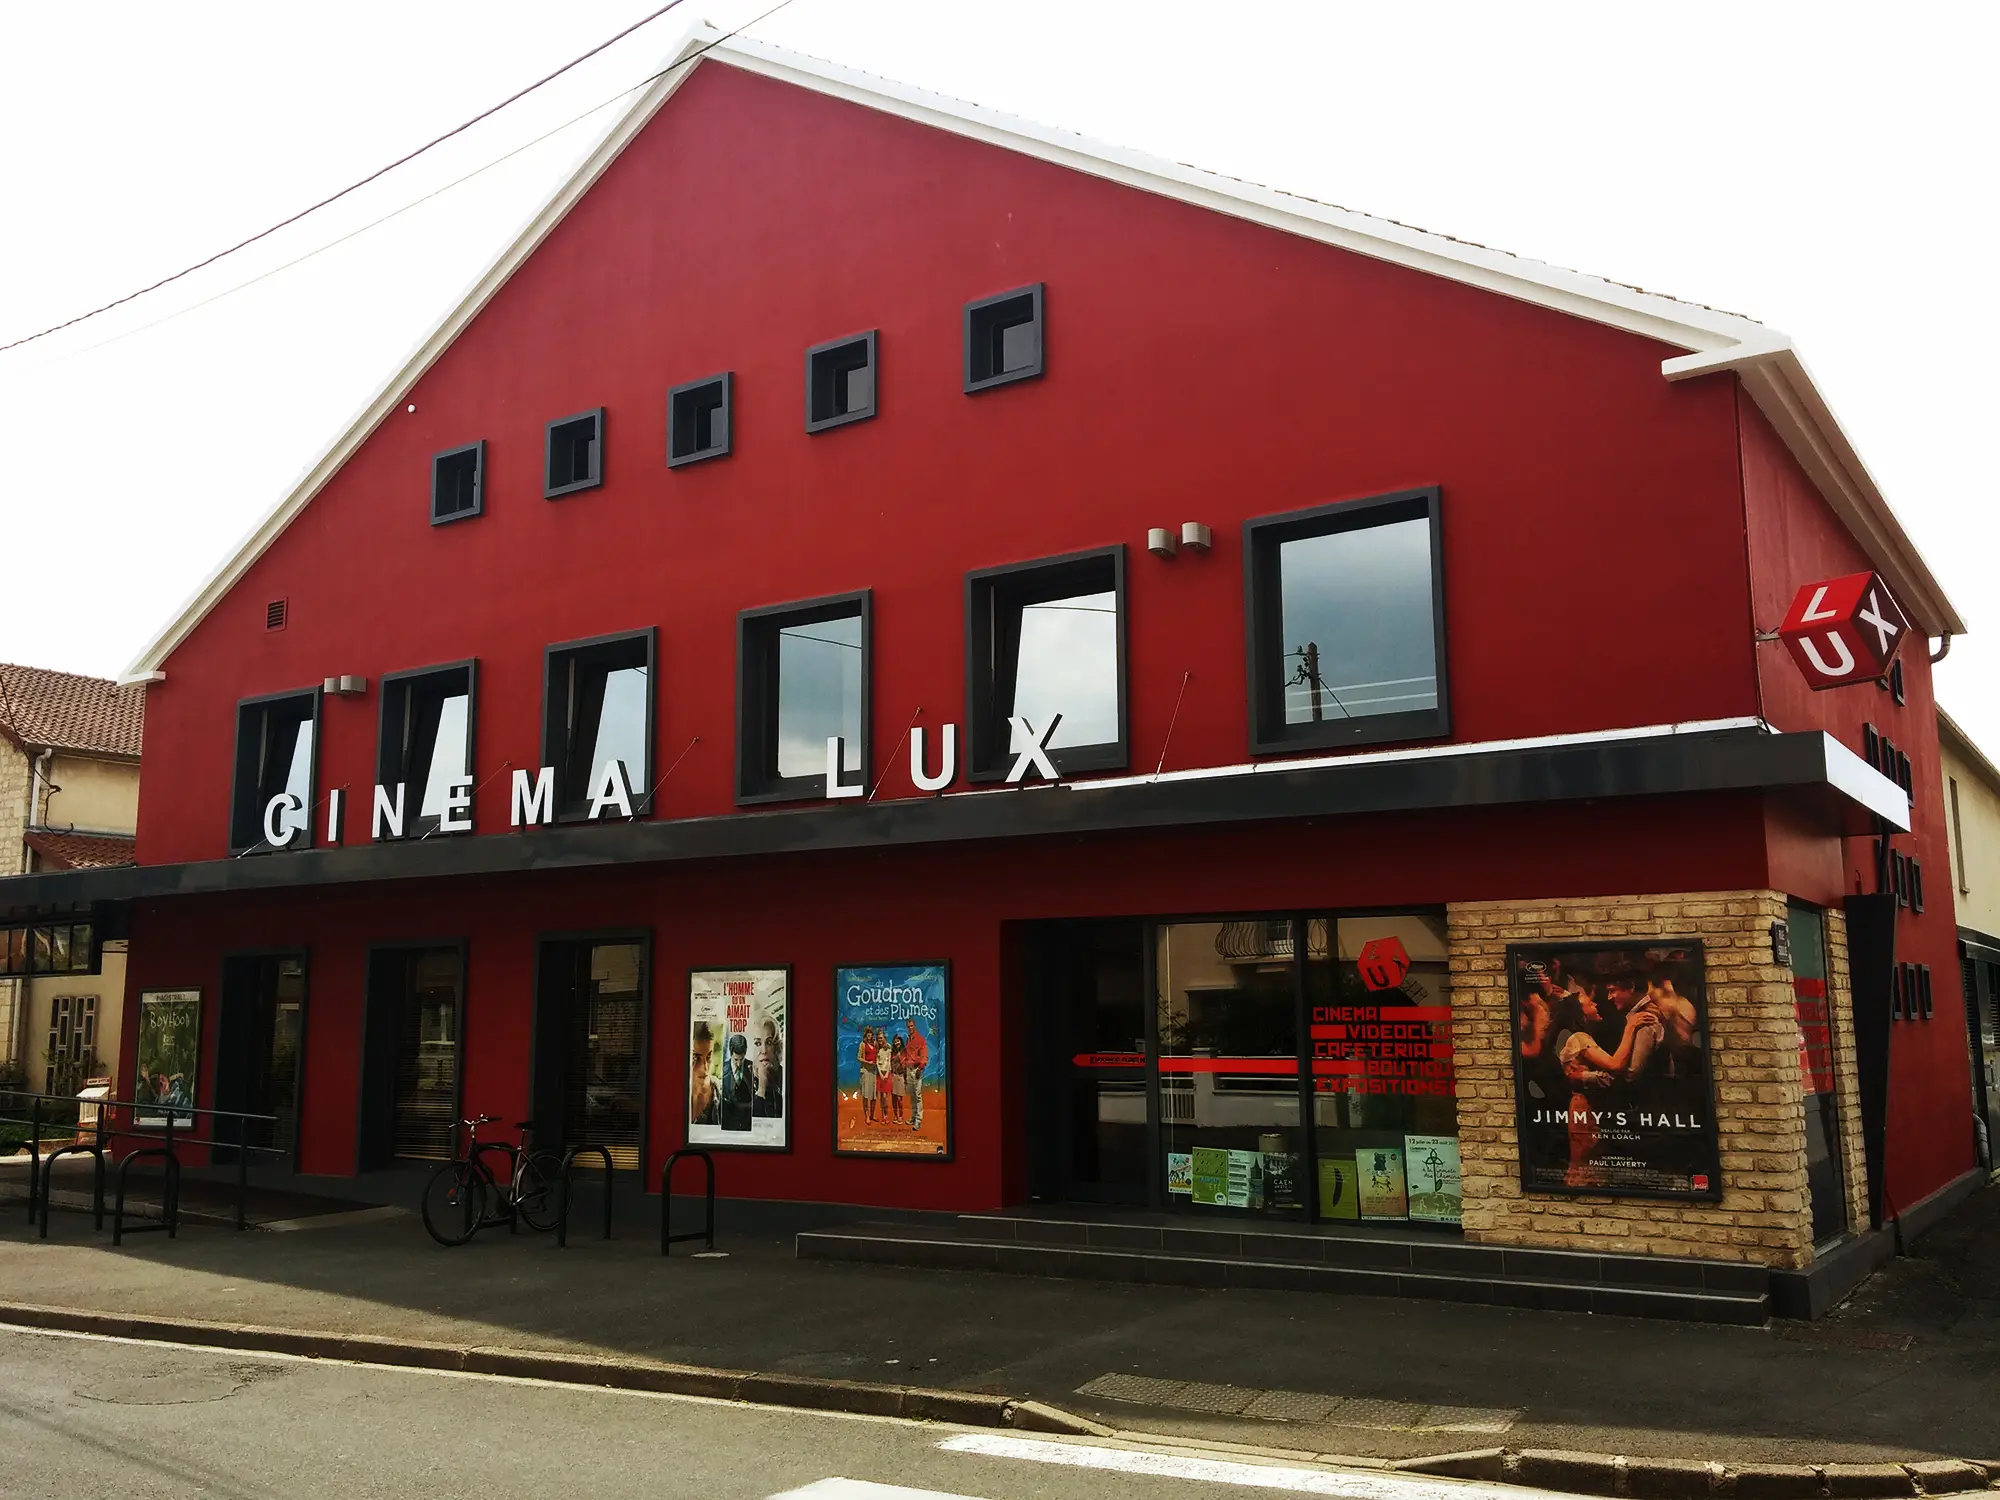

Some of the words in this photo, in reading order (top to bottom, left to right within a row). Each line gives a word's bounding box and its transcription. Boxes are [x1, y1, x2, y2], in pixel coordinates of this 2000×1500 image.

[1800, 586, 1899, 676] LUX
[264, 759, 634, 848] CINEMA
[826, 713, 1063, 799] LUX
[723, 982, 755, 996] L'HOMME
[847, 979, 924, 1006] Goudron
[727, 1005, 751, 1018] AIMAIT
[865, 1006, 873, 1015] et
[874, 1005, 889, 1015] des
[890, 1003, 937, 1020] Plumes
[1313, 1007, 1377, 1022] CINEMA
[730, 1019, 748, 1033] TROP
[1348, 1024, 1452, 1040] VIDEOCLU
[1314, 1042, 1427, 1058] CAFETERIA
[1367, 1060, 1452, 1077] BOUTIQU
[1316, 1077, 1449, 1096] EXPOSITIONS
[1532, 1110, 1628, 1126] JIMMY'S
[1639, 1113, 1702, 1129] HALL
[1611, 1160, 1647, 1168] LAVERTY
